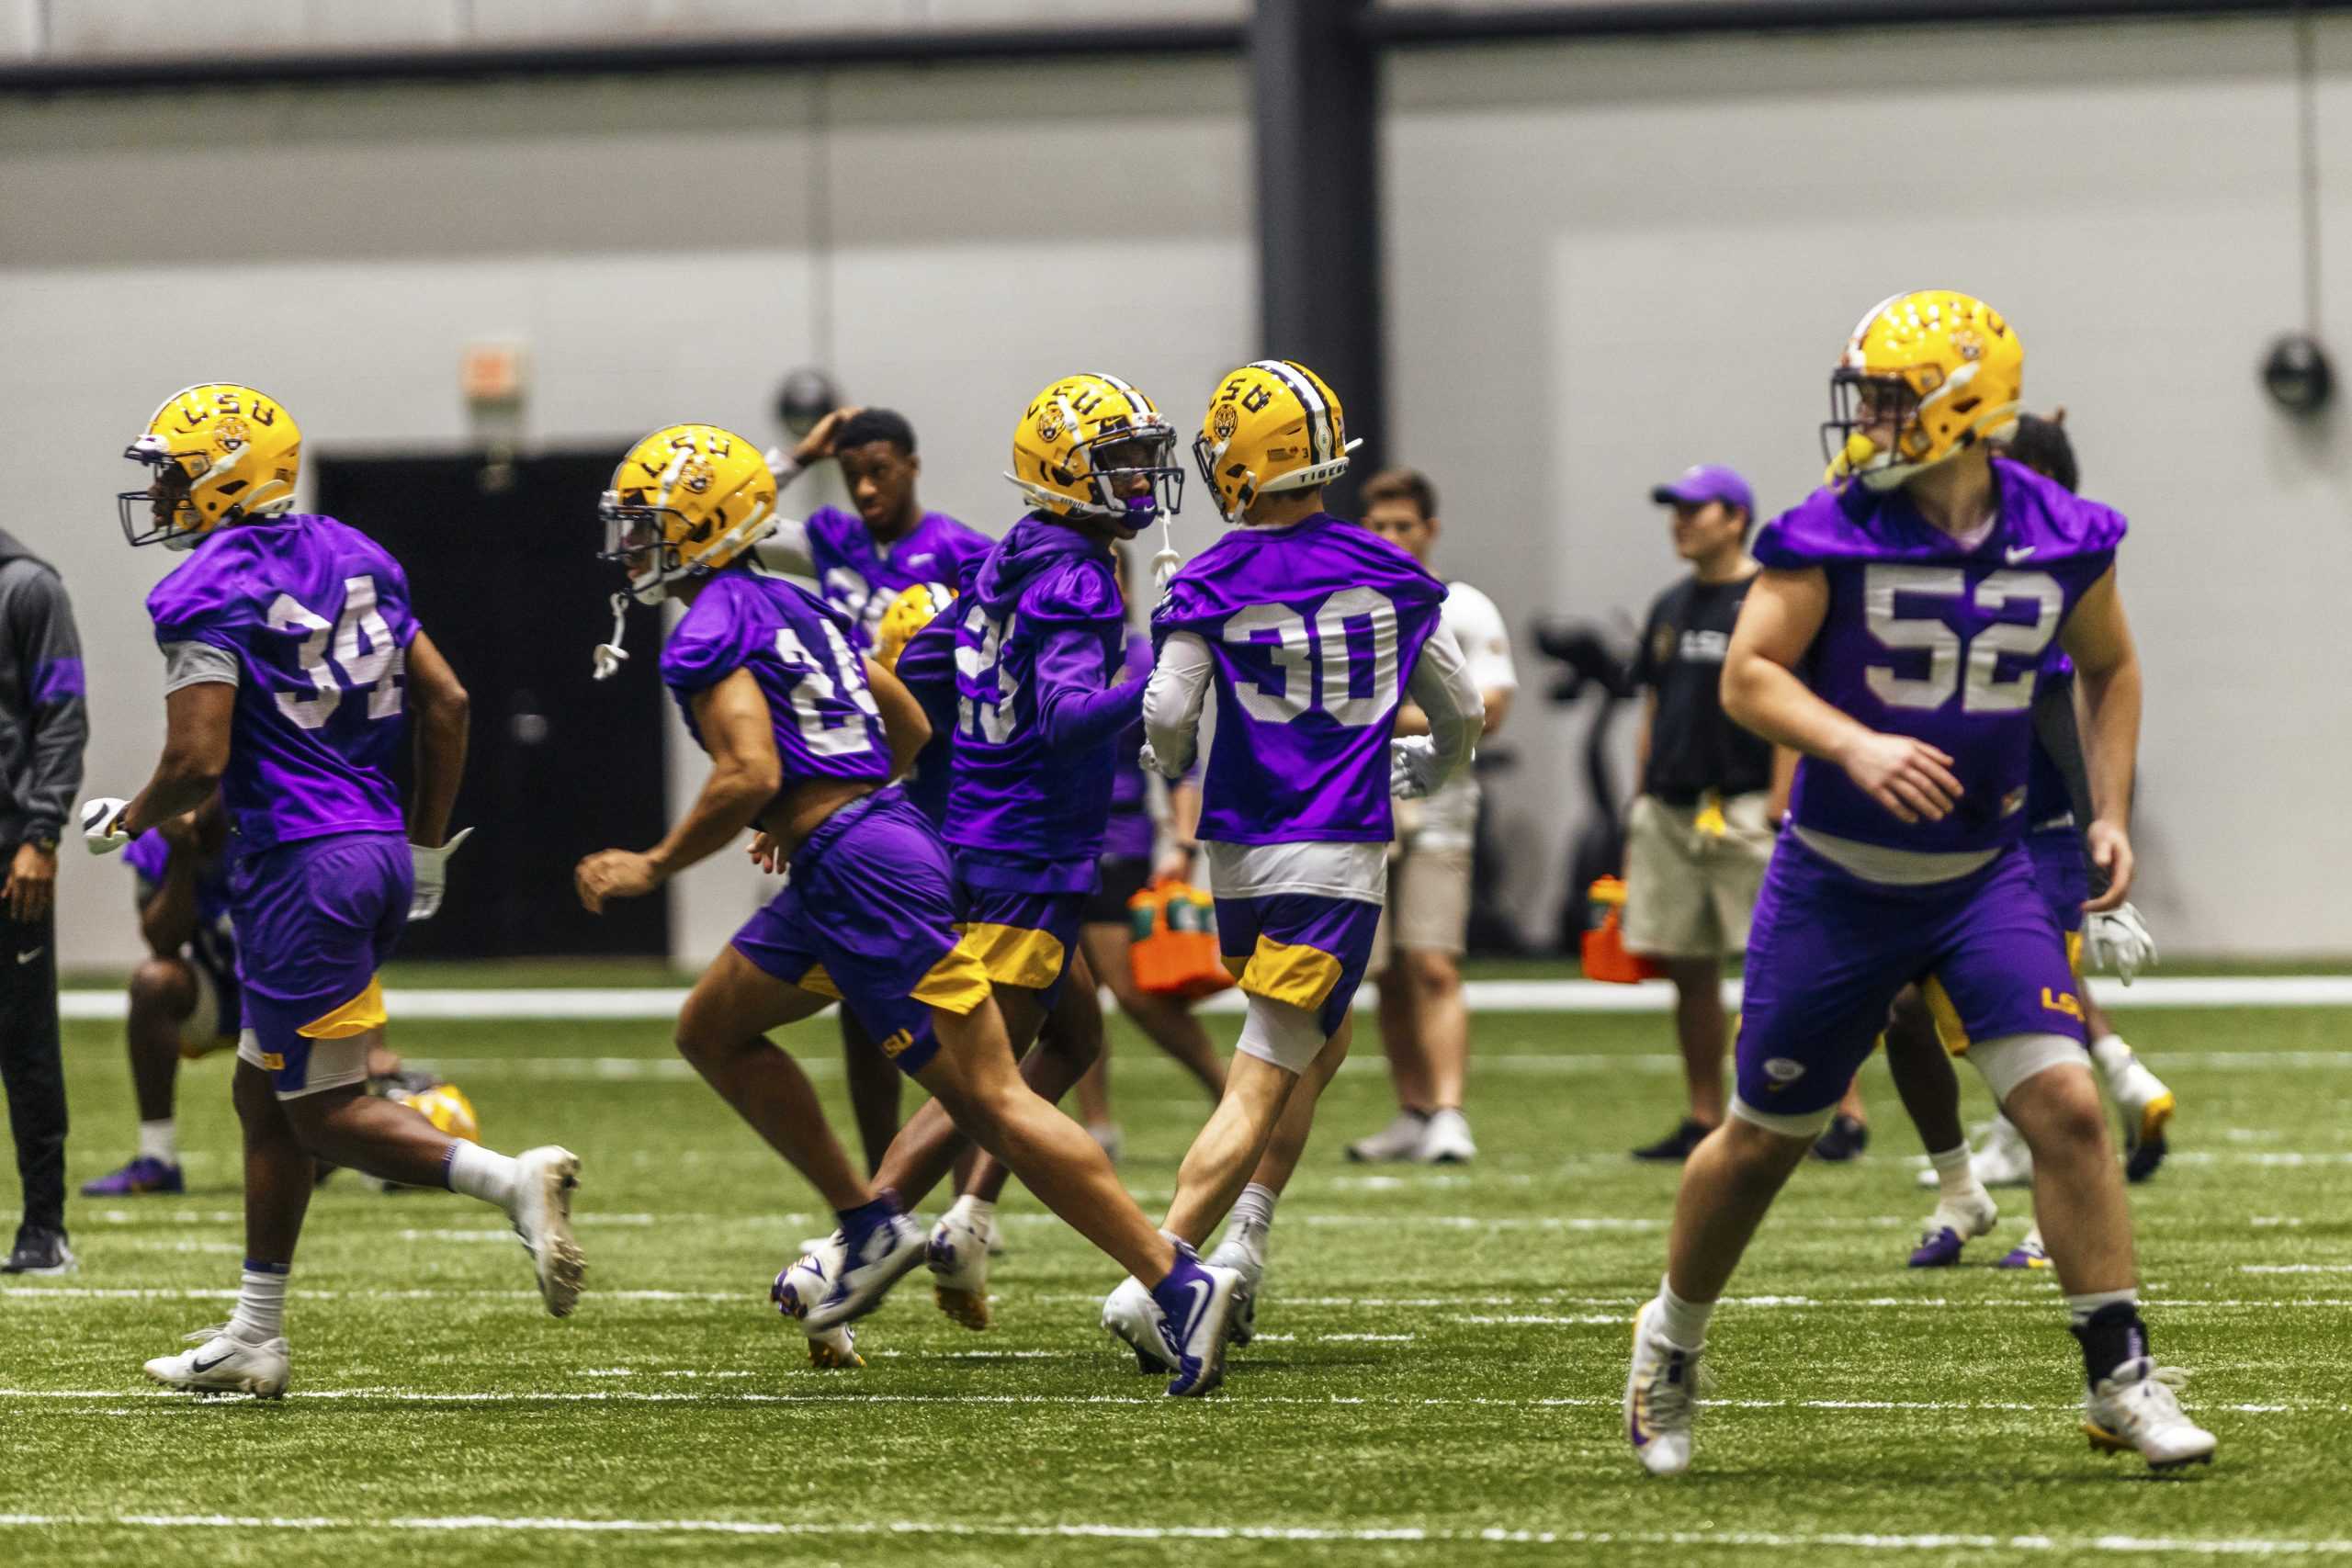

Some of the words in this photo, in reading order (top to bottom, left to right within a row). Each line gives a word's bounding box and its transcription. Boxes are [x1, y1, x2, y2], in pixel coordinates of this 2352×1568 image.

[184, 394, 274, 426] LSU
[640, 435, 730, 478] LSU
[267, 575, 405, 729] 34
[1223, 585, 1398, 727] 30
[1865, 563, 2064, 713] 52
